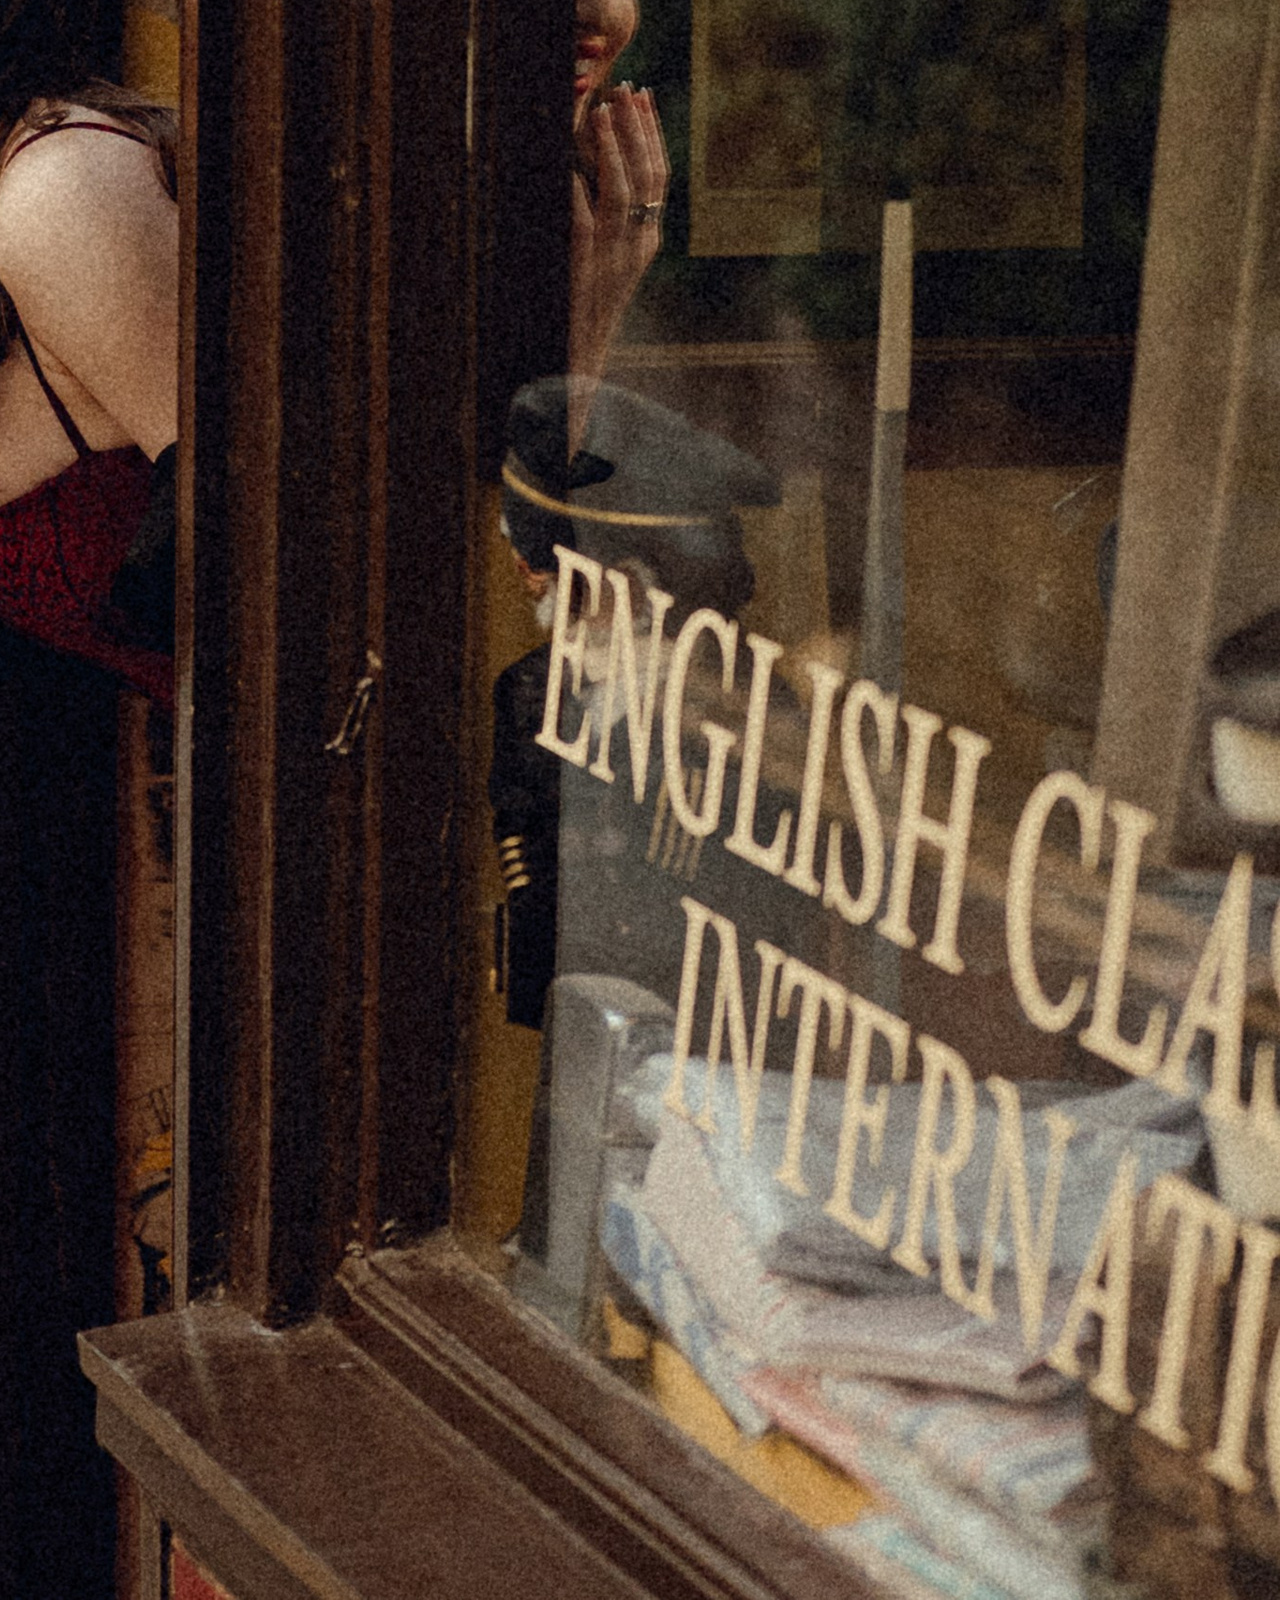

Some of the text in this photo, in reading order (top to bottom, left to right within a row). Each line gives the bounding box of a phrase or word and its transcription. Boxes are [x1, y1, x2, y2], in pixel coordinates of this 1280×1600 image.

[534, 543, 1280, 1142] ENGLISH CLA
[662, 894, 1280, 1506] INTERNATI
